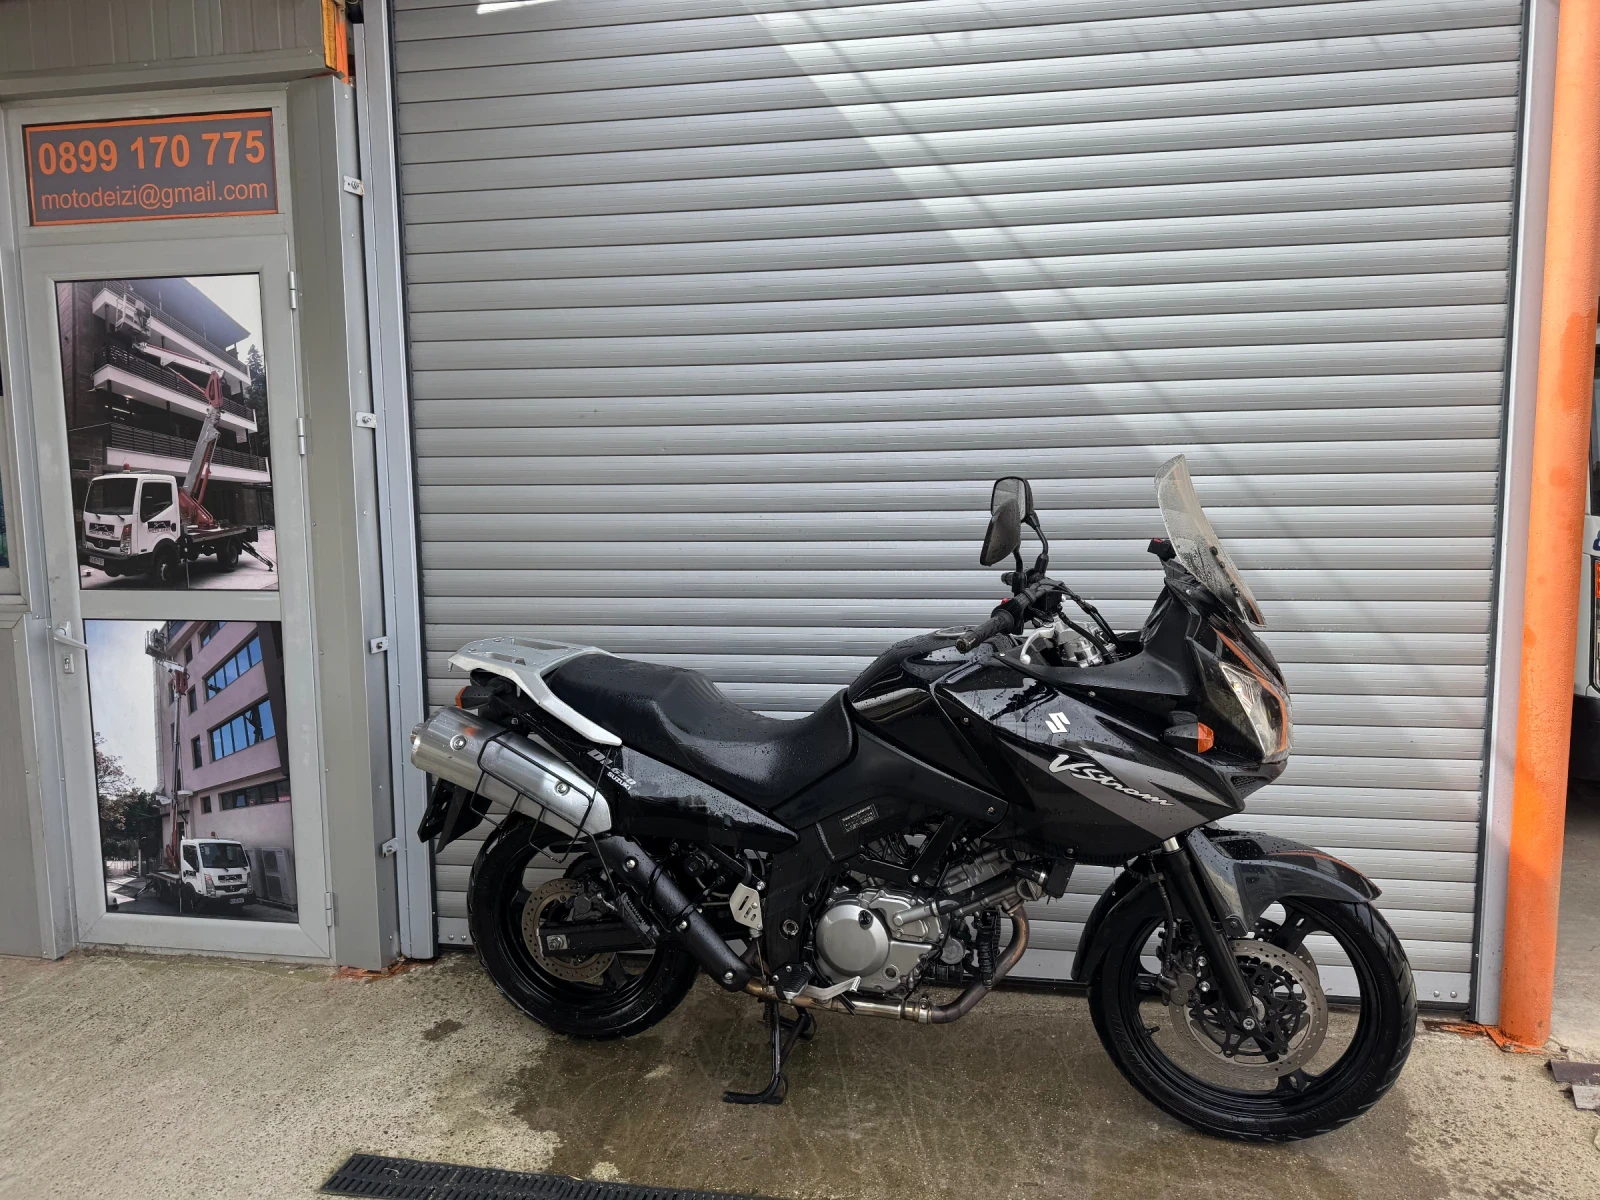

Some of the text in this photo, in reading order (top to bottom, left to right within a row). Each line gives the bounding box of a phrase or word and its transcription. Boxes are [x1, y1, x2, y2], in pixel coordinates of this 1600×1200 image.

[38, 130, 265, 176] 0899 170 775
[41, 181, 268, 210] motodeizi@gmail.com
[607, 771, 632, 791] SUZUKI
